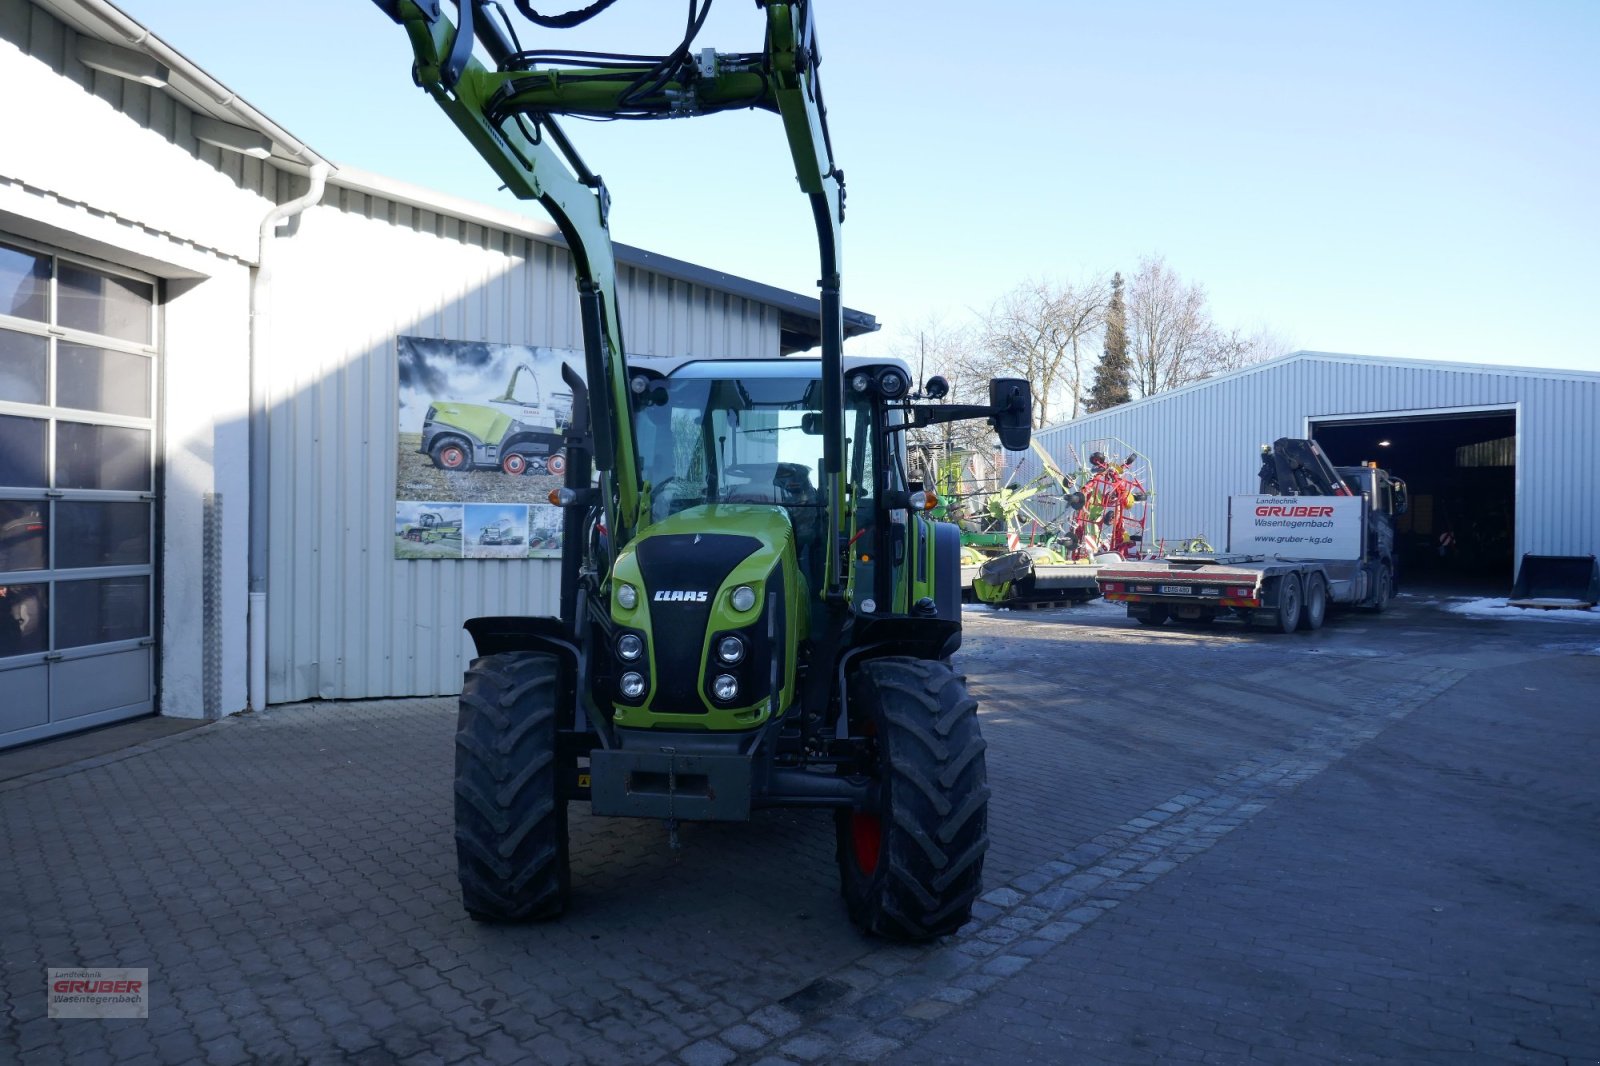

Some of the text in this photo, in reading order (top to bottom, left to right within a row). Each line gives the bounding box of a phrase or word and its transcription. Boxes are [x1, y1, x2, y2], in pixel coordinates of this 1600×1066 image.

[1255, 506, 1334, 517] GRUBER
[1254, 519, 1334, 529] Wasentegernbach
[1254, 535, 1333, 544] www.gruber-kg.de
[653, 590, 708, 602] CLAAS
